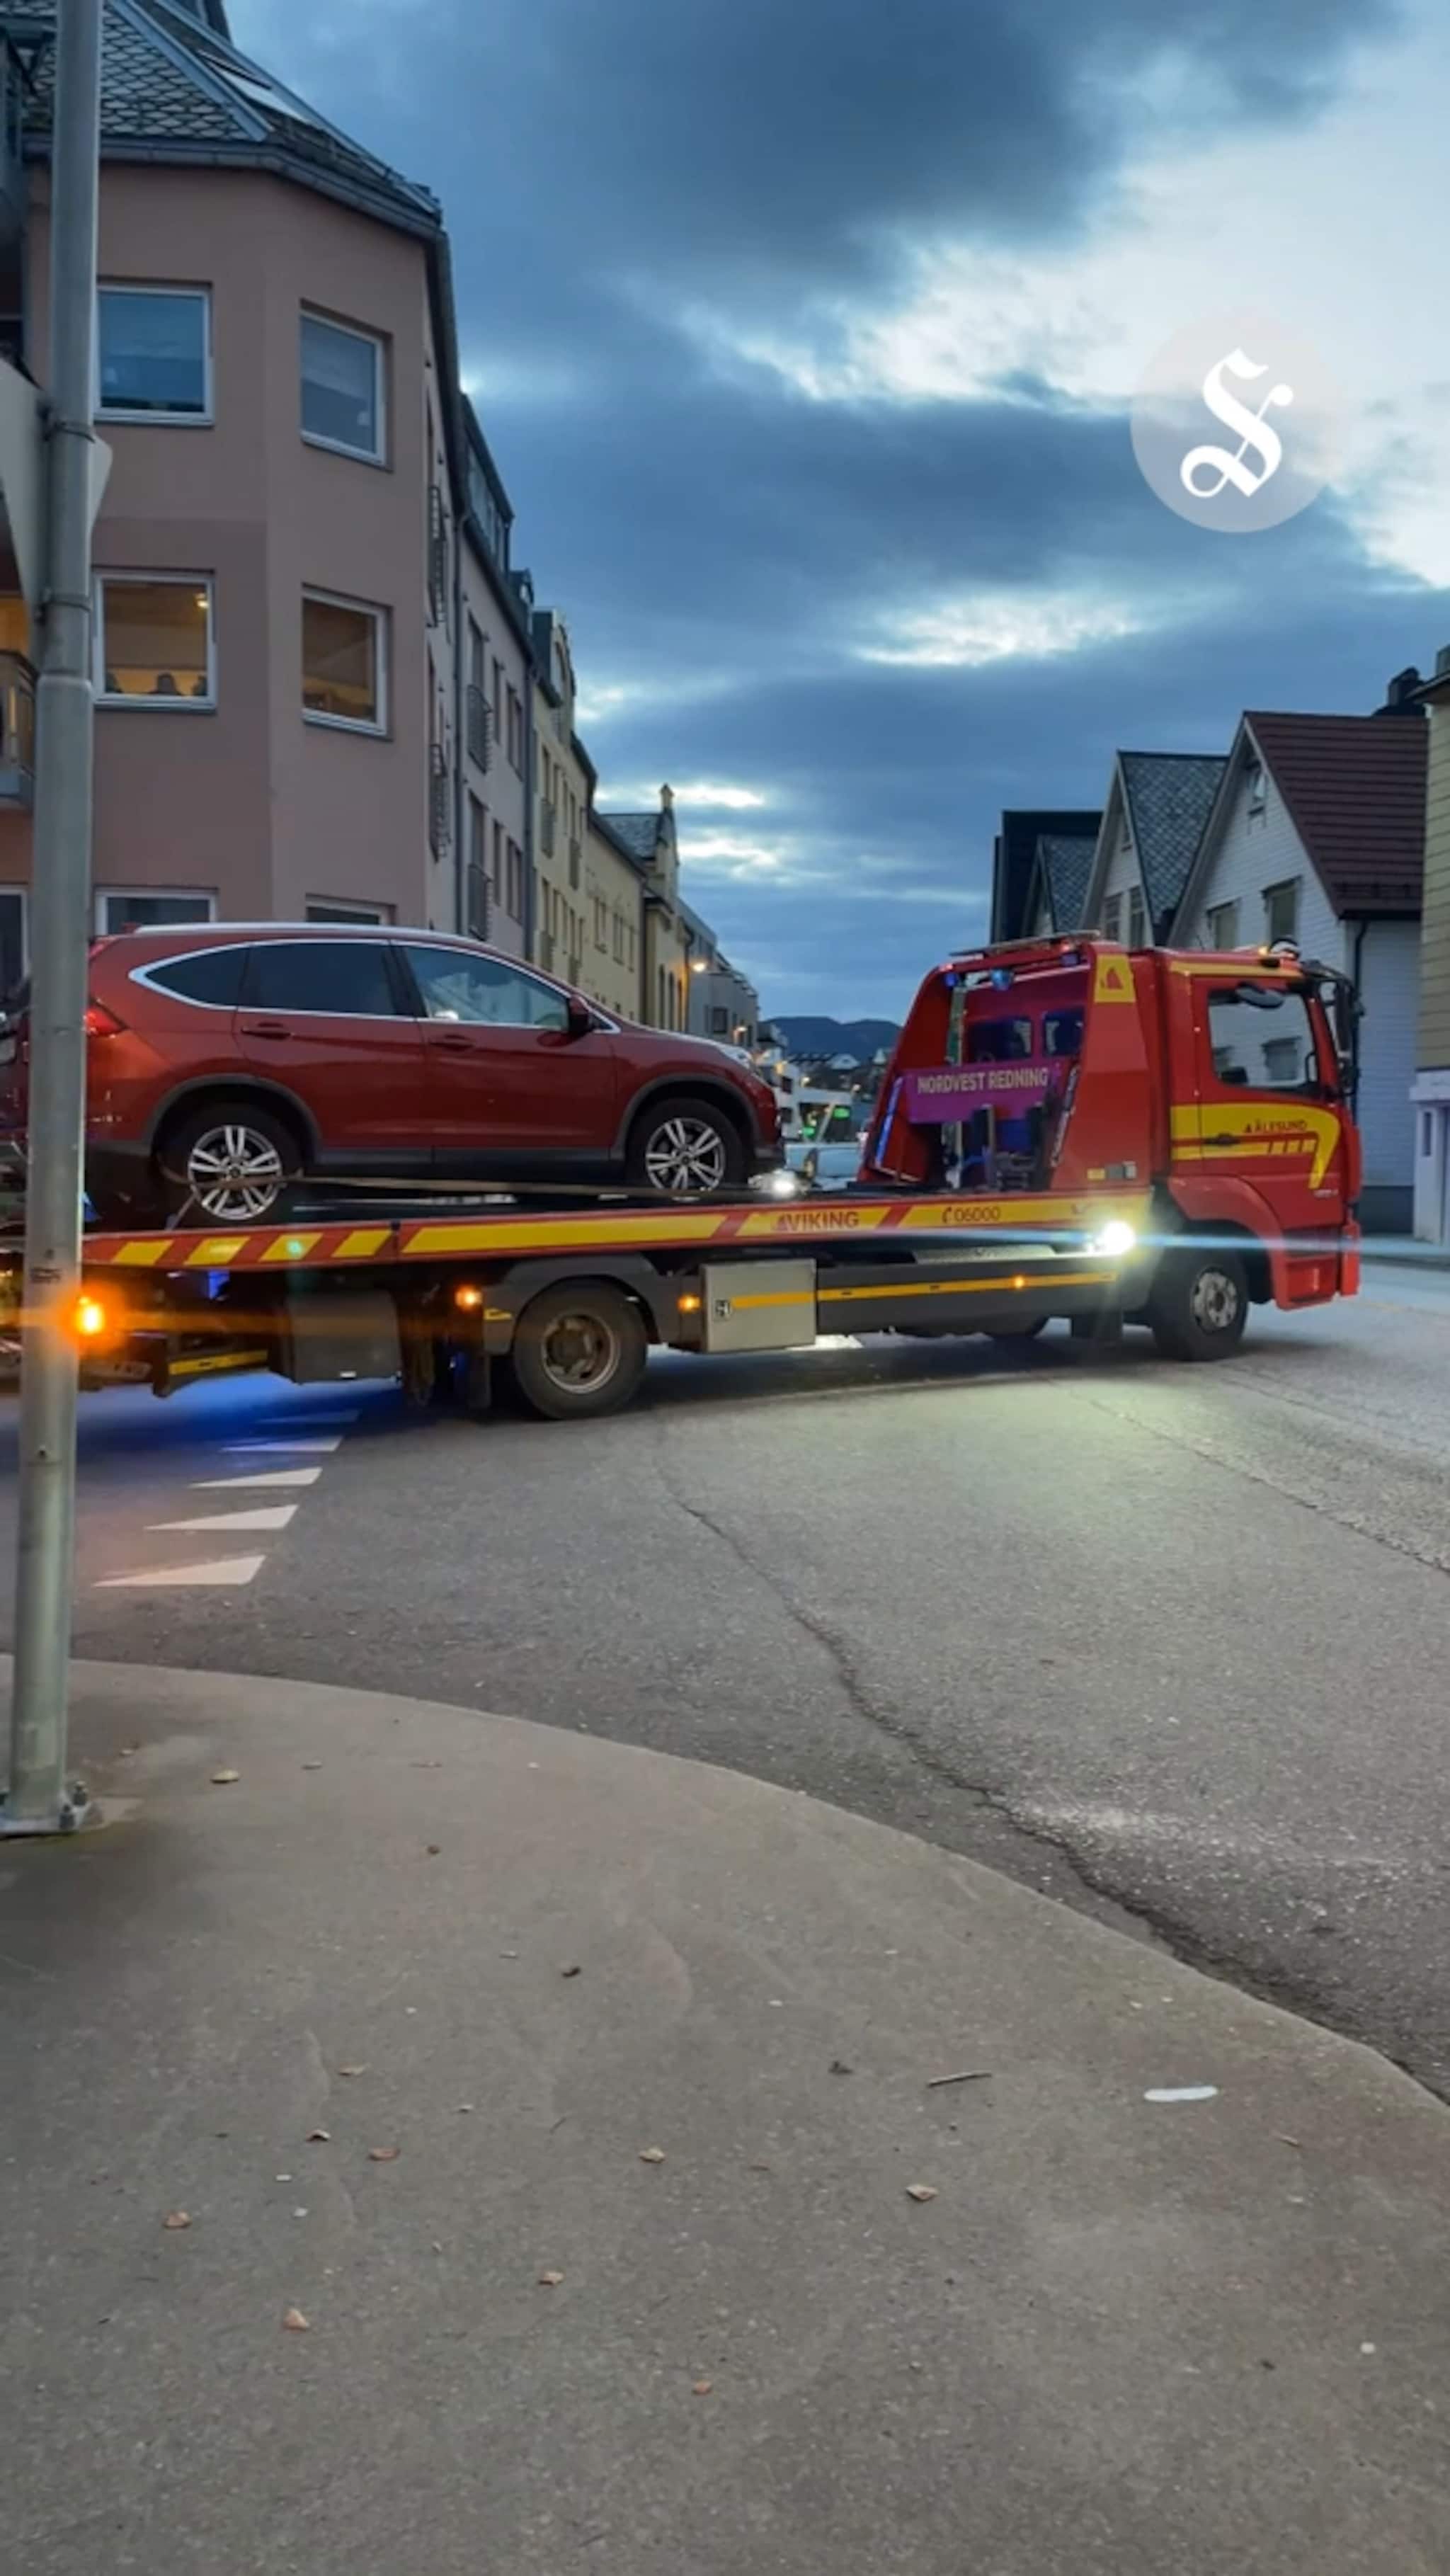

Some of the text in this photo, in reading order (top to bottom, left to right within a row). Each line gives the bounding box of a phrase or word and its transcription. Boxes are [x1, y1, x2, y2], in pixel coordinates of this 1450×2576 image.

[918, 1068, 1049, 1094] NORDVEST REDNING
[786, 1212, 860, 1231] VIKING
[954, 1207, 1001, 1221] 06000
